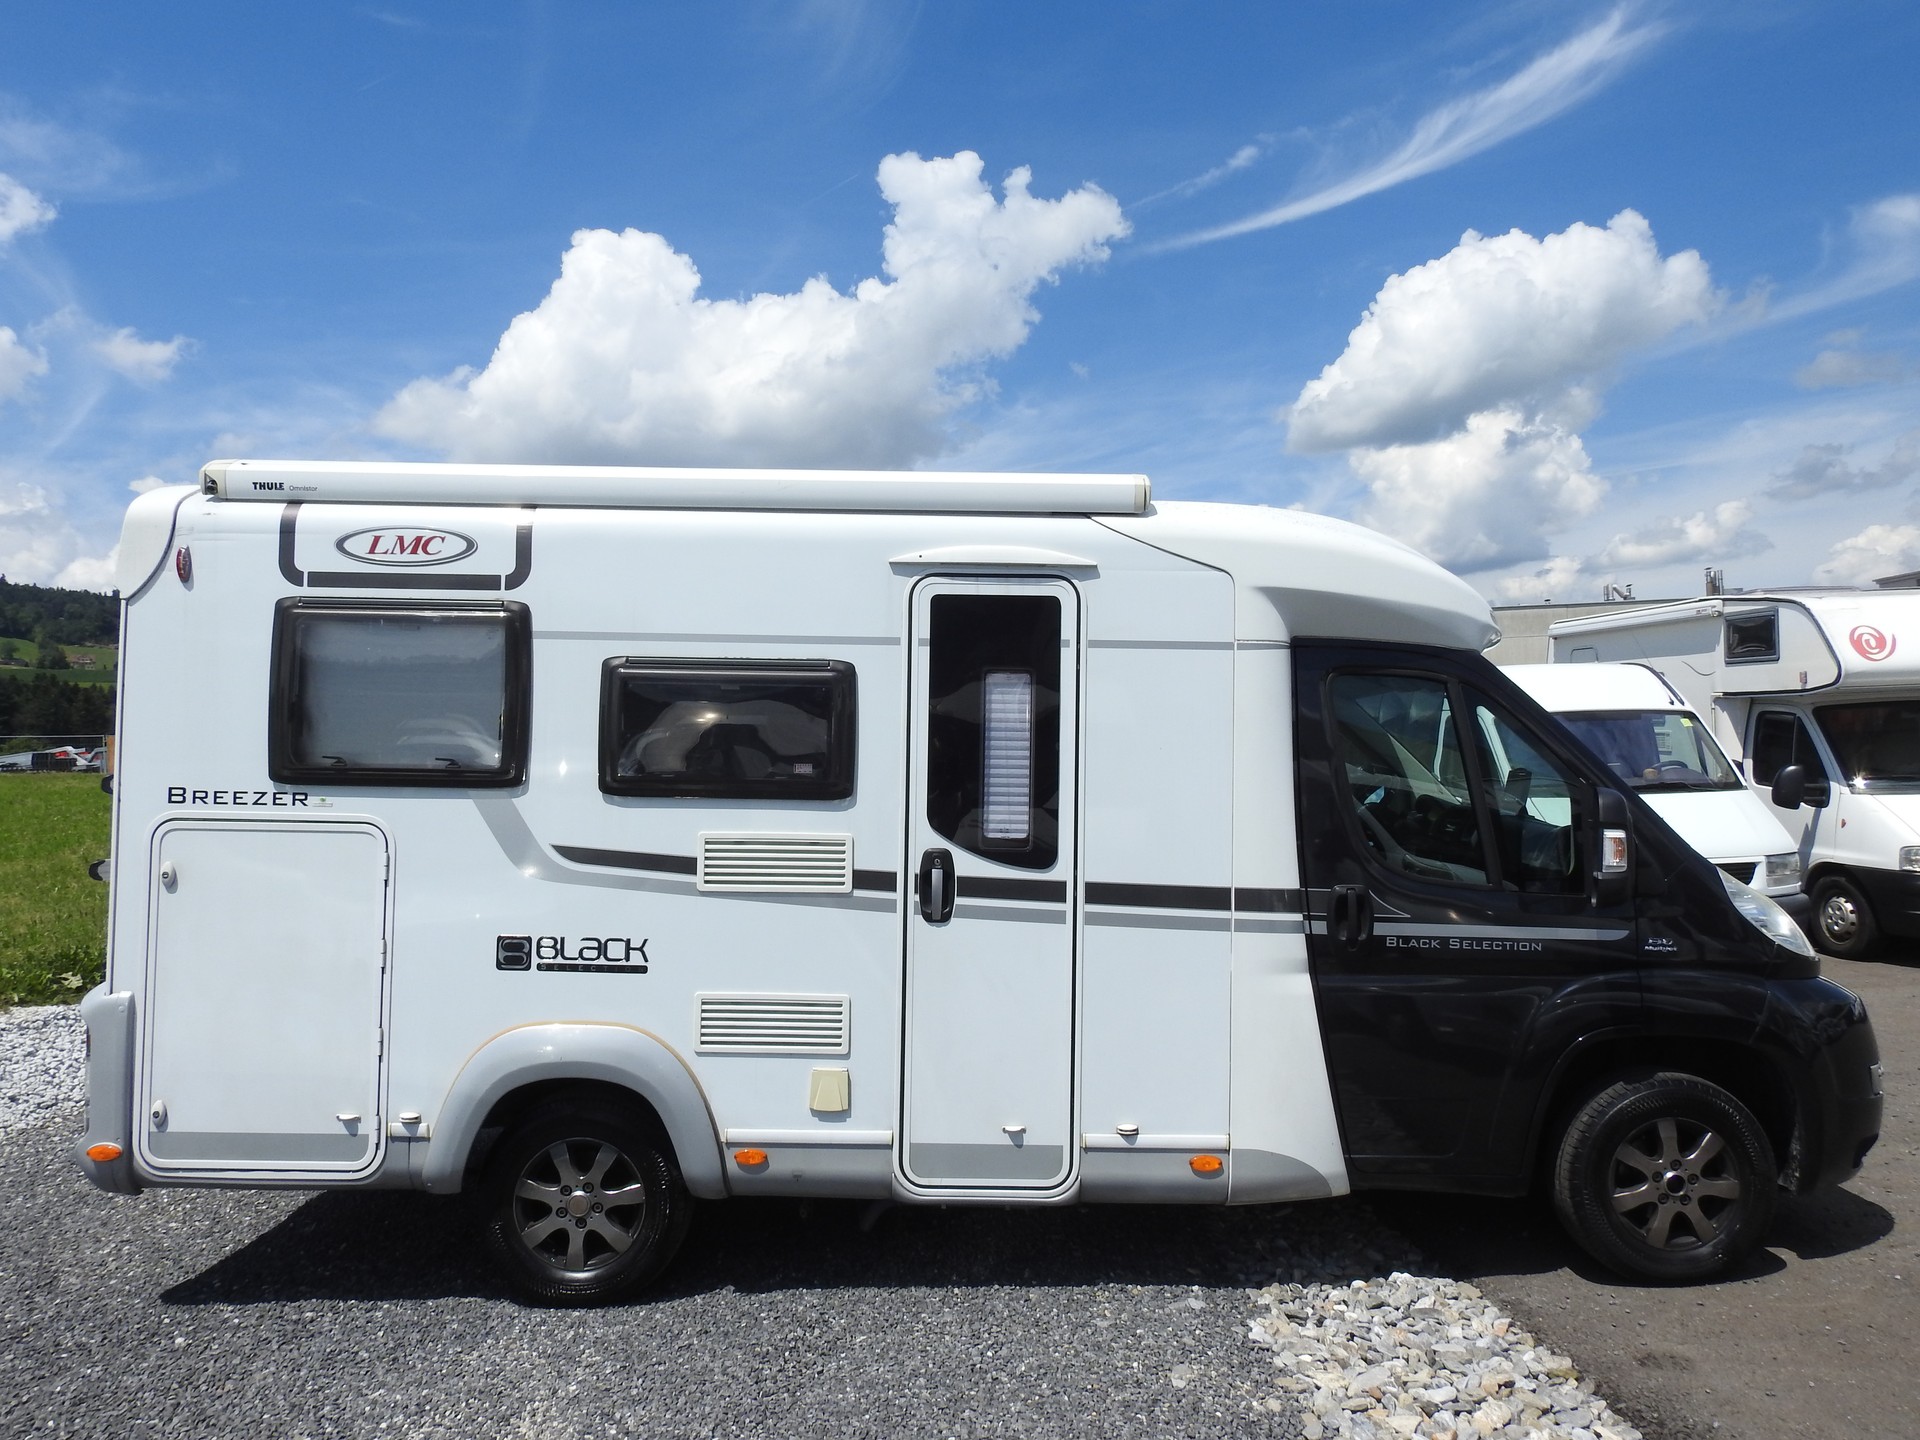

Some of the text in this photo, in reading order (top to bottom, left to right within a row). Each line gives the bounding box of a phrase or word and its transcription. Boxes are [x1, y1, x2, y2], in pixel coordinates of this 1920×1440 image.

[252, 481, 318, 492] THULE Omnistor
[365, 534, 447, 556] LMC
[167, 786, 309, 807] BREEZER
[1386, 936, 1542, 951] BLACK SELECTION
